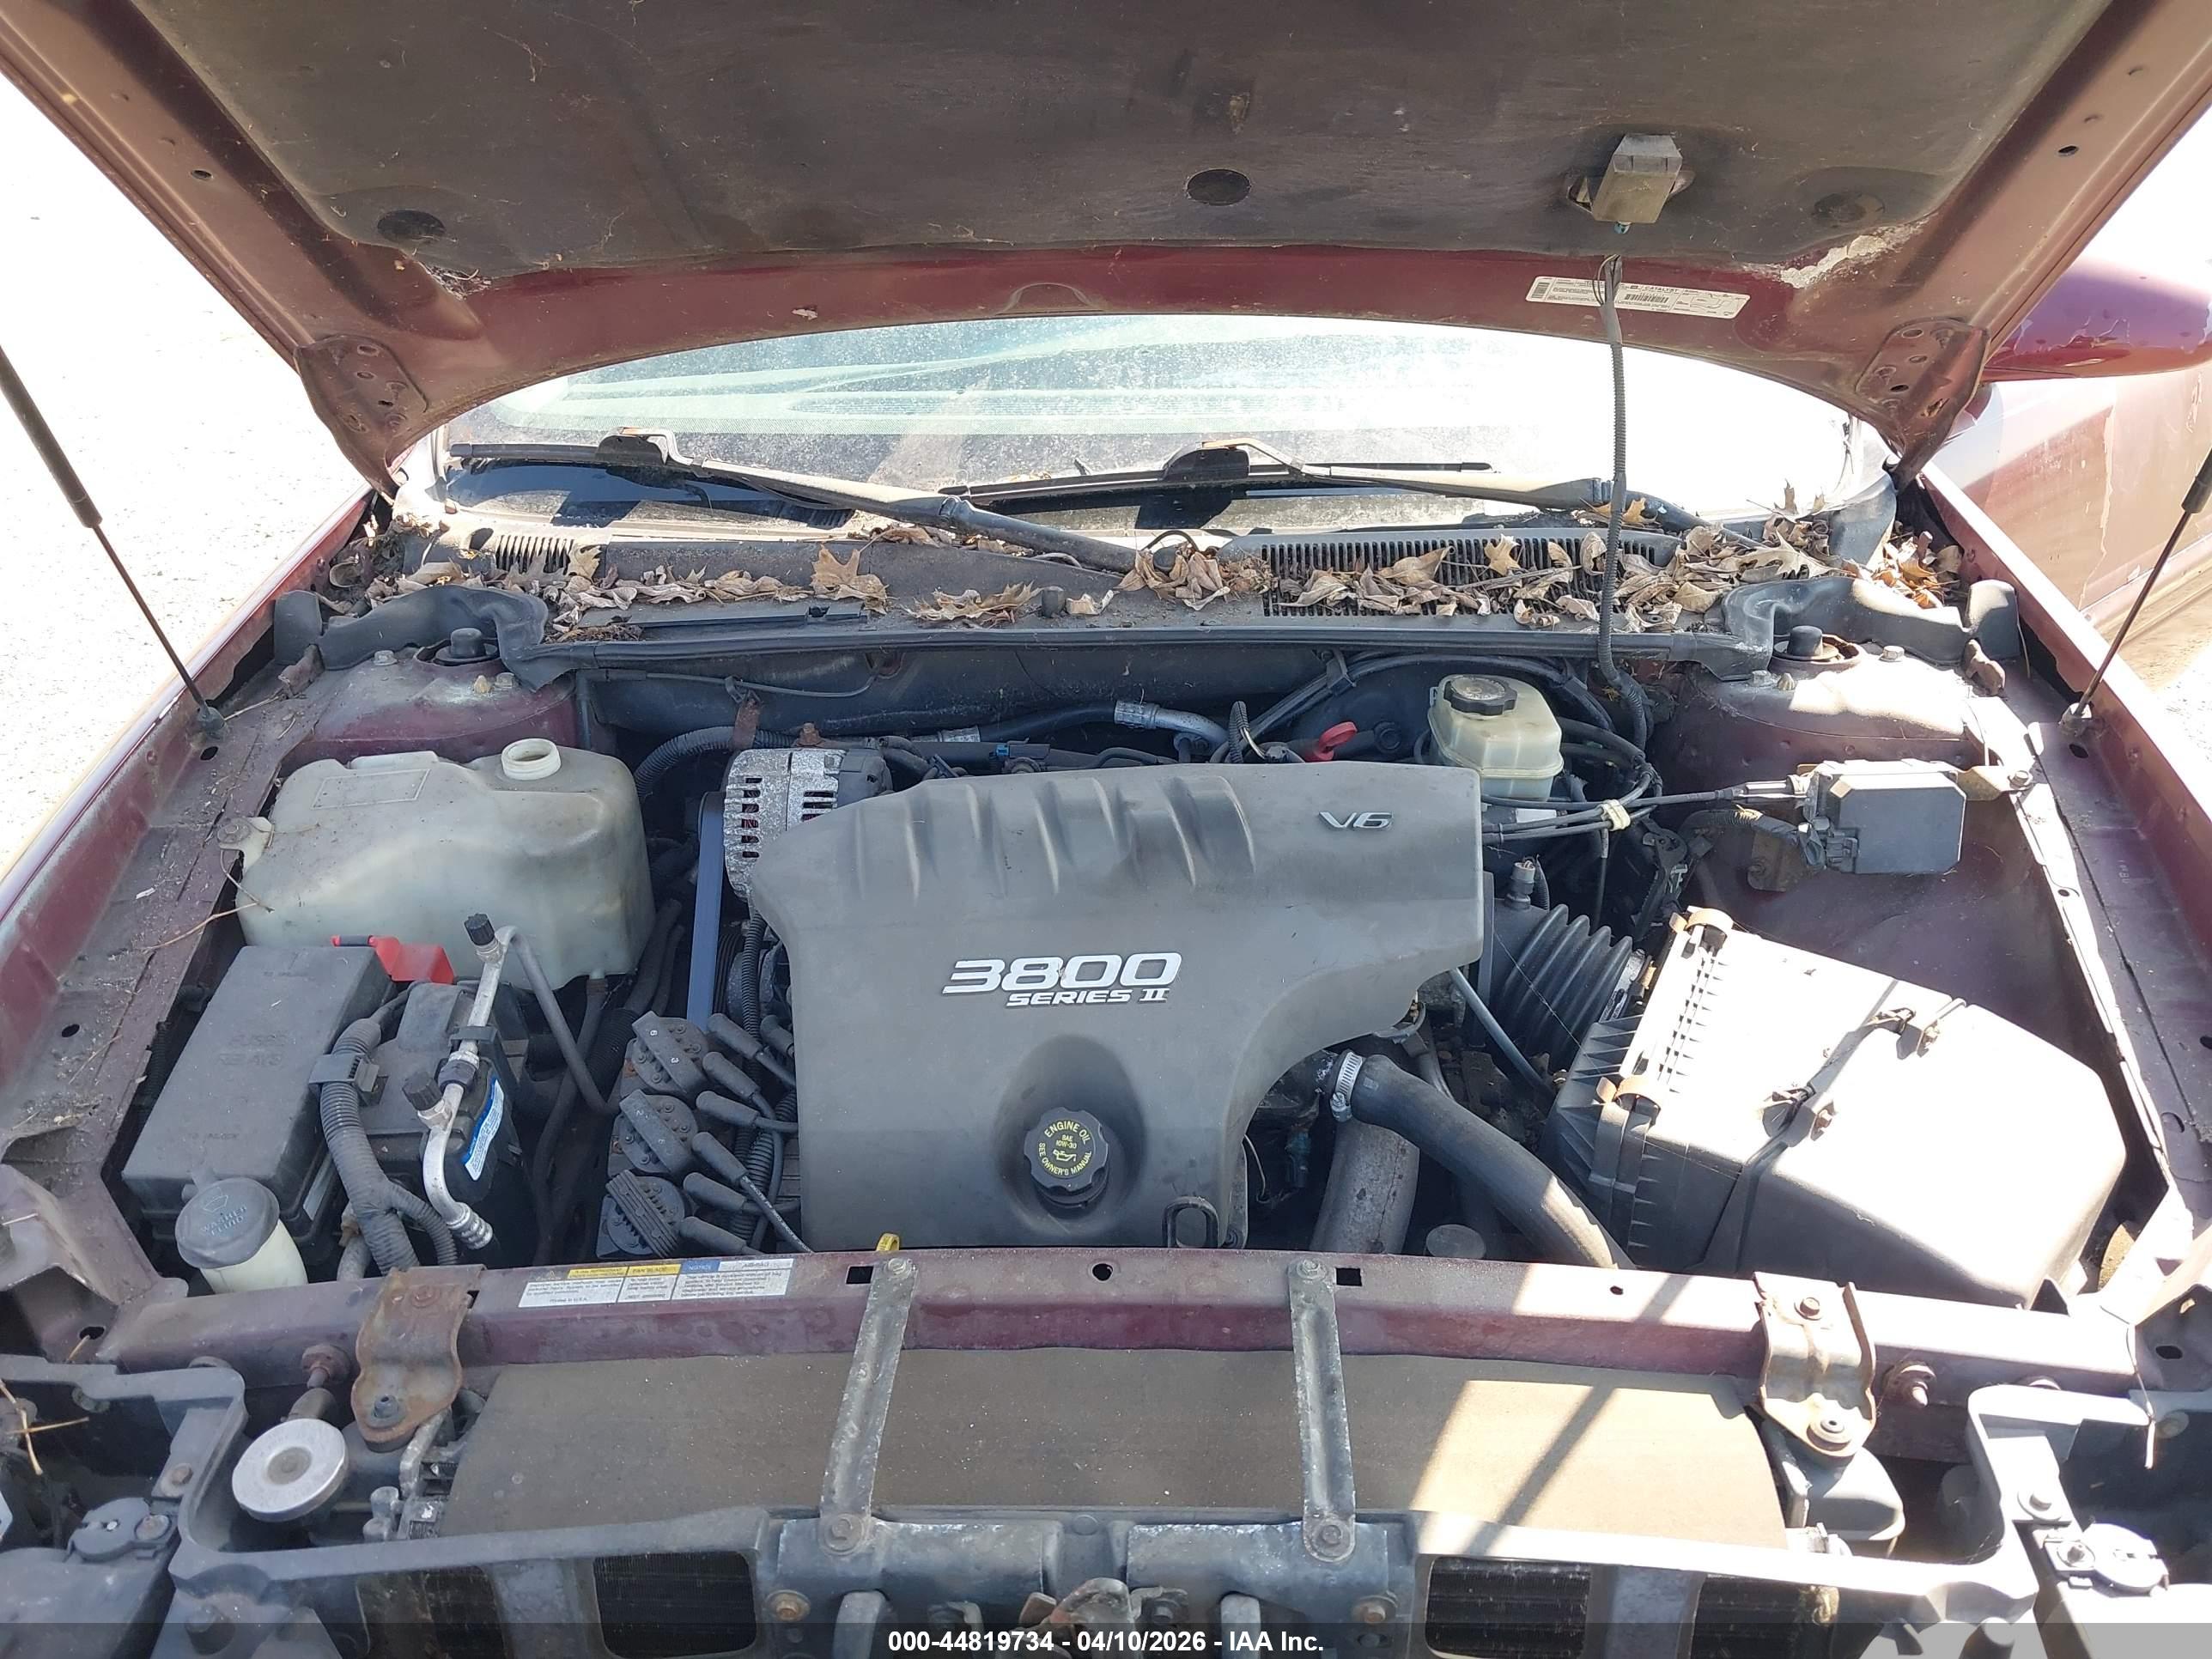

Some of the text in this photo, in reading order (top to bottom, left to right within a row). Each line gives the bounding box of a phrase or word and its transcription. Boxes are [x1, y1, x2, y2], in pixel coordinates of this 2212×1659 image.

[1318, 811, 1394, 830] V6
[941, 951, 1183, 995] 3800
[1006, 988, 1170, 1007] SERIES II
[1044, 1121, 1091, 1146] ENGINE OIL
[1055, 1139, 1078, 1149] 10W-30
[1042, 1157, 1070, 1176] OWNER'S
[1070, 1151, 1092, 1176] MANUAL
